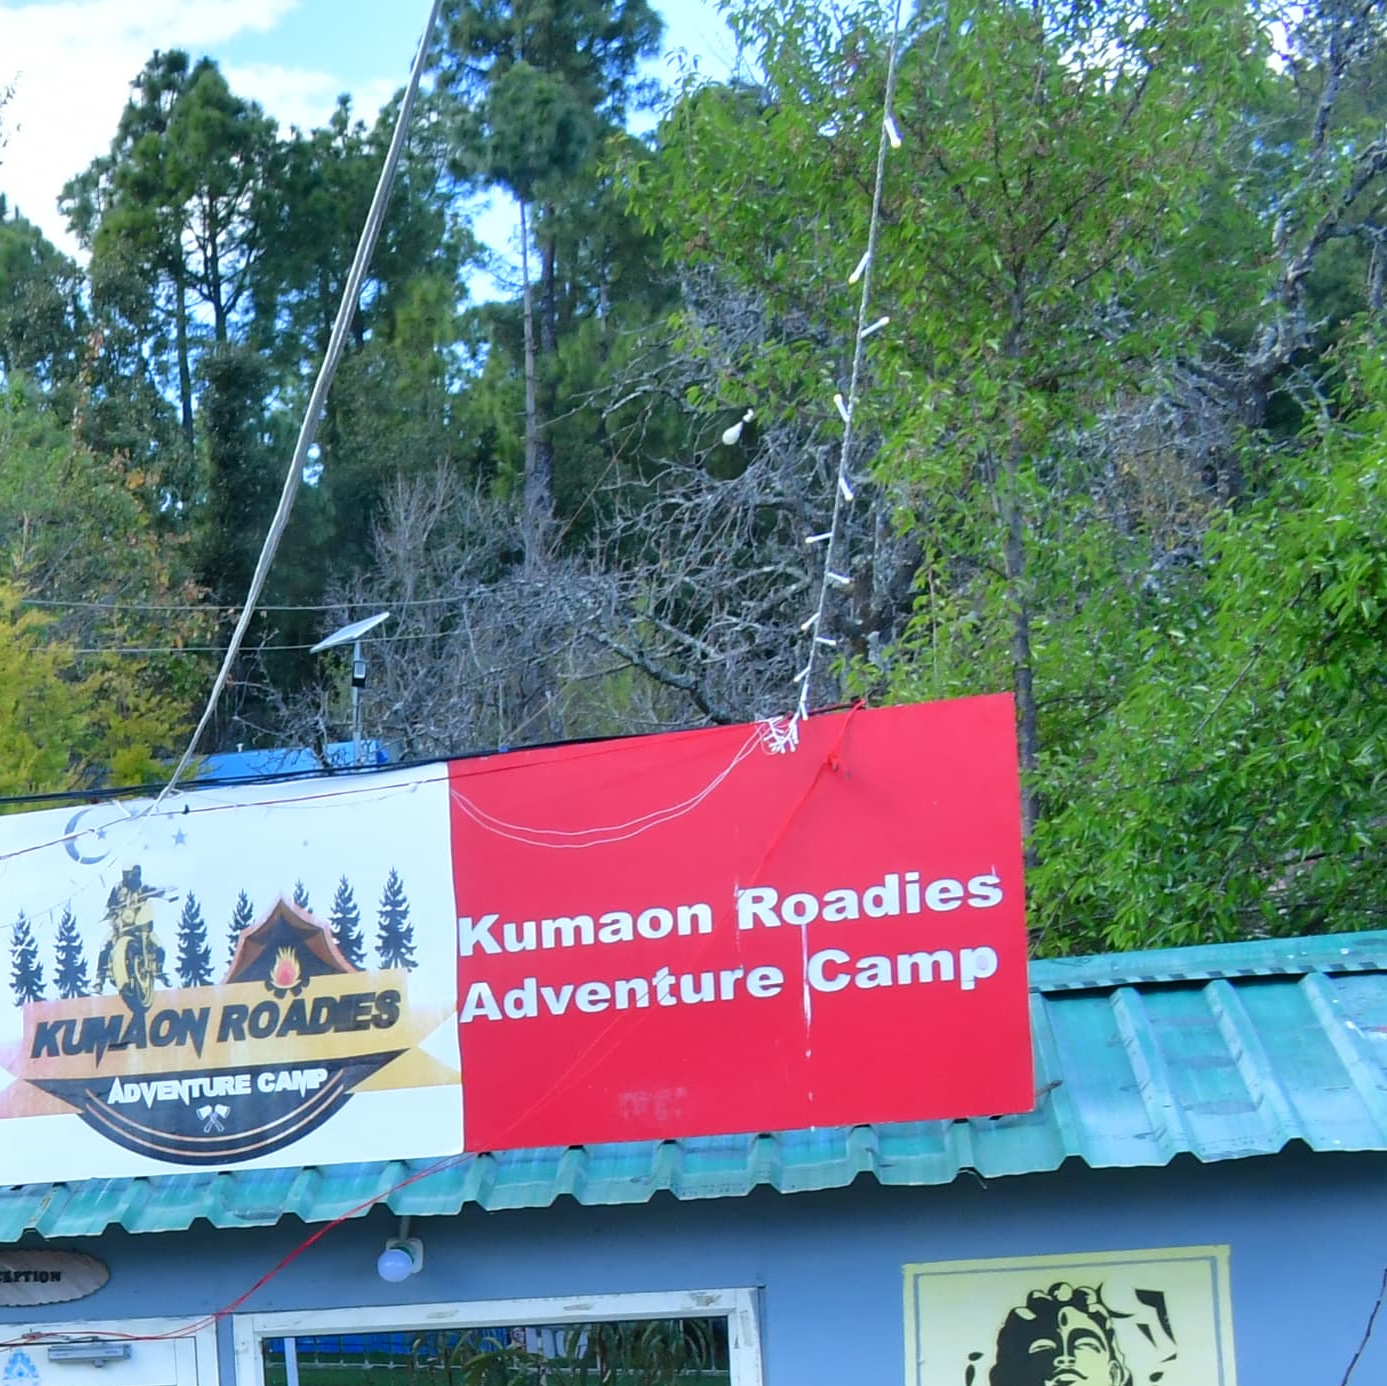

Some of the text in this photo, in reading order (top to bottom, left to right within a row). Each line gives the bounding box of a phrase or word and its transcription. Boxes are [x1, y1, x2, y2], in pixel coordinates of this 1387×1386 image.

[458, 871, 1004, 957] Kumaon Roadies
[459, 945, 999, 1024] Adventure Camp
[29, 988, 401, 1069] KUMAON ROADIES
[107, 1067, 329, 1109] ADVENTURE CAMP
